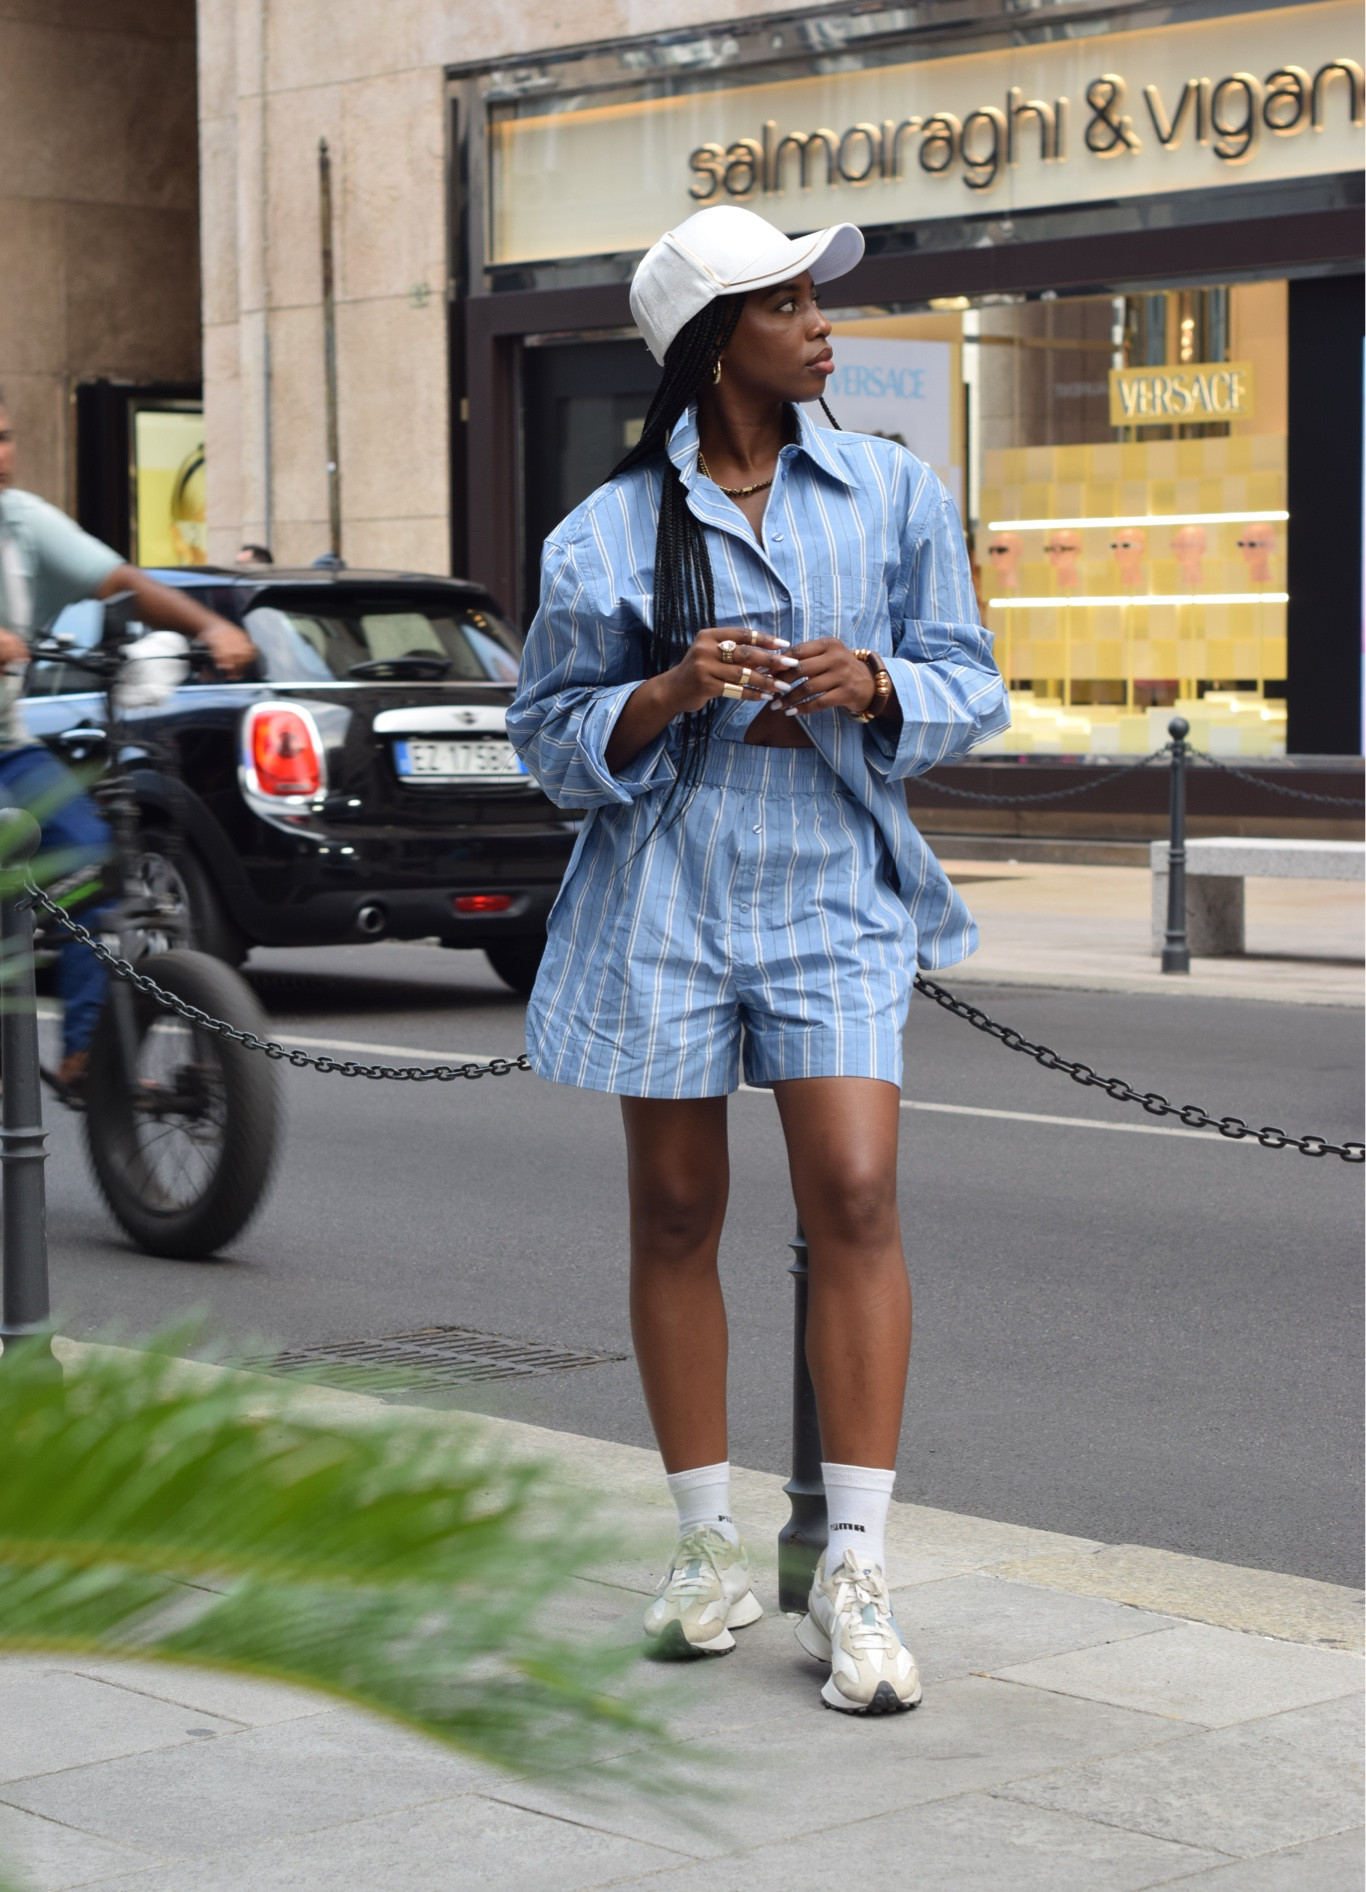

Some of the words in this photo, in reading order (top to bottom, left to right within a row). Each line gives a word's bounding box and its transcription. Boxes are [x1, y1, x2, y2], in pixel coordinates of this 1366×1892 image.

[687, 86, 1070, 204] salmoiraghi
[1083, 73, 1142, 160] &
[829, 364, 927, 401] VERSACE
[1116, 370, 1247, 418] VERSACE
